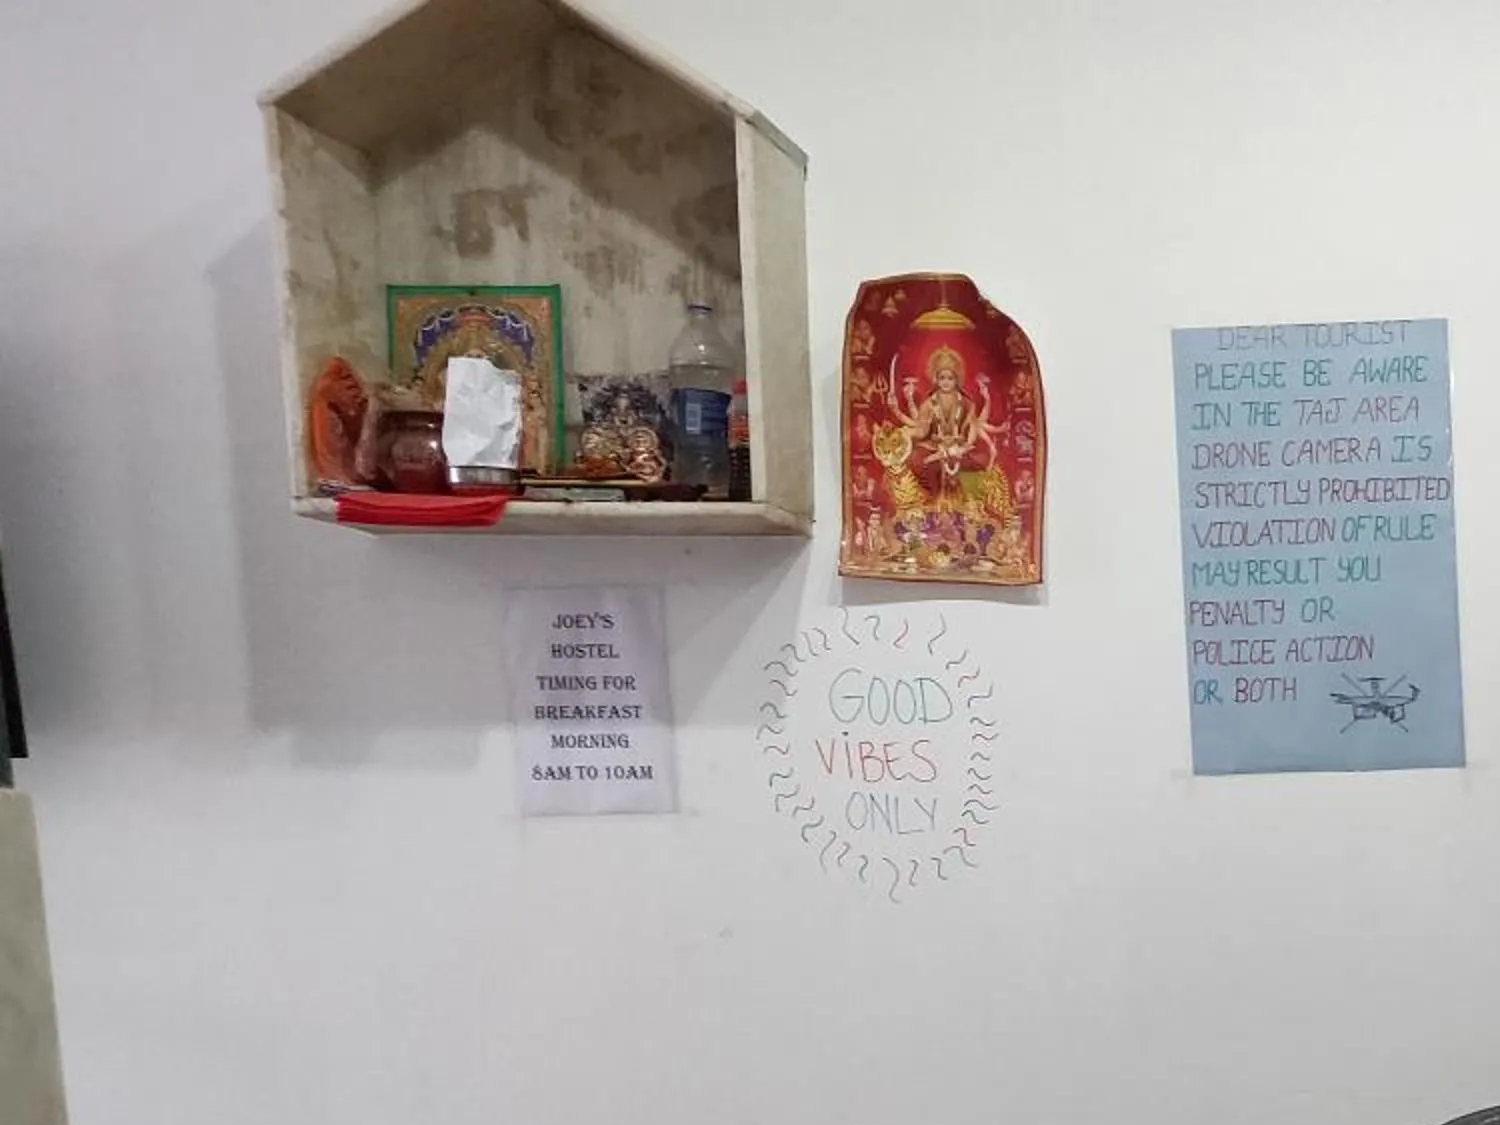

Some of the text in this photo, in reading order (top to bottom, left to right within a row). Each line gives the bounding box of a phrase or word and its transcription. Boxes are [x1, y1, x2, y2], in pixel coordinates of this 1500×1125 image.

[1217, 320, 1414, 351] DEAR TOURIST
[1195, 356, 1428, 390] PLEASE BE AWARE
[1191, 396, 1419, 430] IN THE TAJ AREA
[1192, 435, 1432, 470] DRONE CAMERA IS
[1195, 477, 1449, 508] STRICTLY PROHIBITED
[1192, 514, 1437, 548] VIOLATION OF RULE
[1192, 556, 1381, 588] MAY RESULT YOU
[552, 612, 615, 629] JOEY'S
[1190, 597, 1336, 627] PENALTY OR
[551, 643, 620, 659] HOSTEL
[1193, 636, 1374, 666] POLICE ACTION
[536, 676, 636, 690] TIMING FOR
[829, 667, 953, 725] GOOD
[1193, 677, 1297, 705] OR BOTH
[534, 705, 643, 720] BREAKFAST
[550, 733, 629, 749] MORNING
[531, 765, 653, 780] 8AM TO 10AM
[846, 791, 939, 834] ONLY
